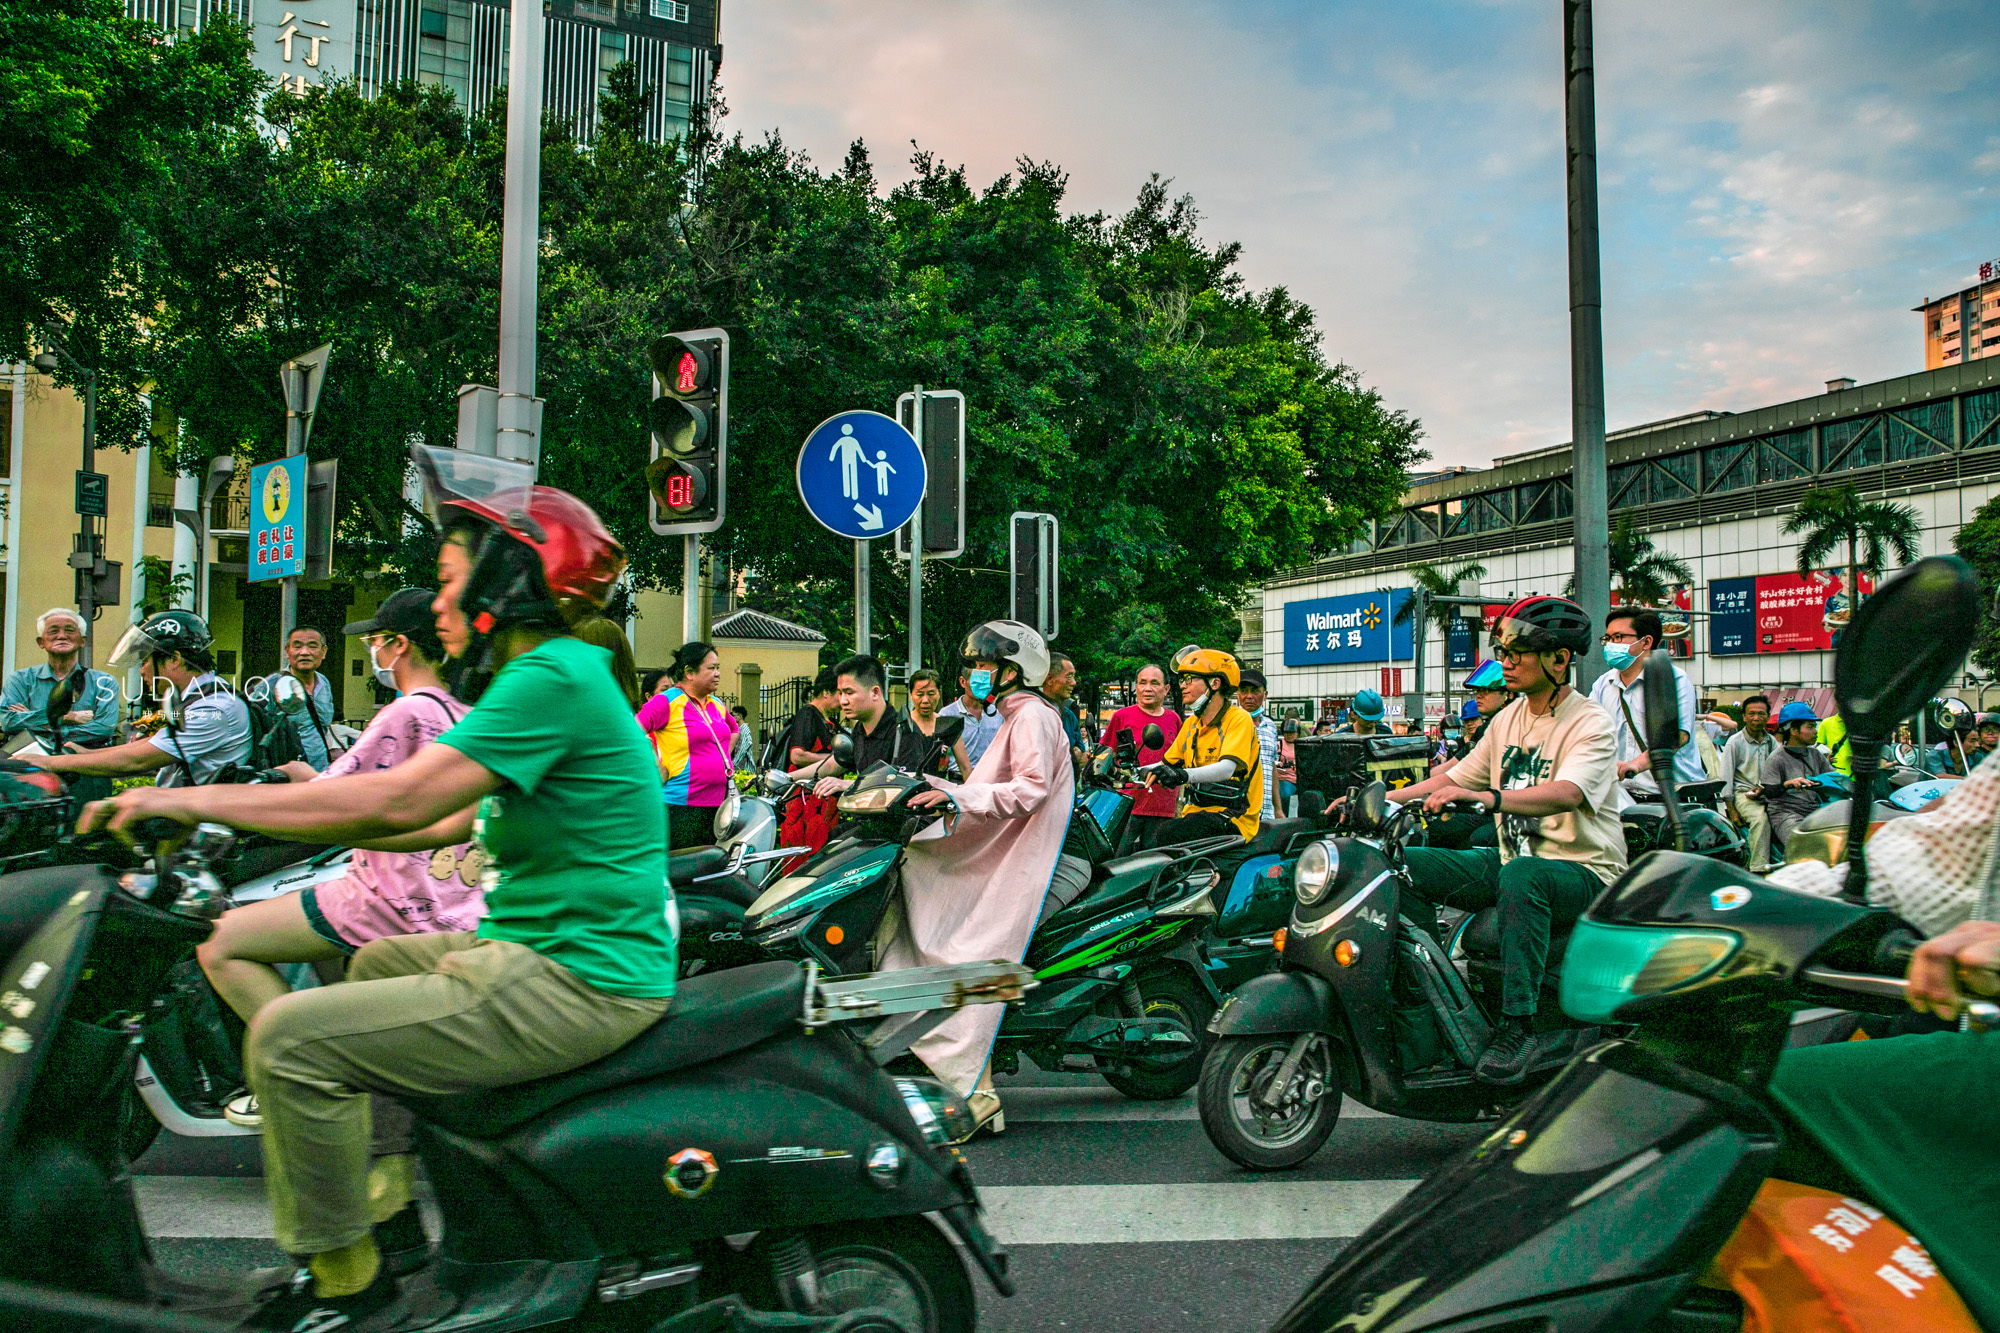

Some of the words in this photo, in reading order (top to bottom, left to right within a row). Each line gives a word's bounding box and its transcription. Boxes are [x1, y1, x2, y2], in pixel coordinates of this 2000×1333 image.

[258, 525, 294, 547] 我礼让
[257, 543, 294, 565] 我自豪
[1760, 585, 1823, 599] 好山好水好食材
[1306, 608, 1363, 631] Walmart
[1306, 630, 1363, 651] 沃尔玛
